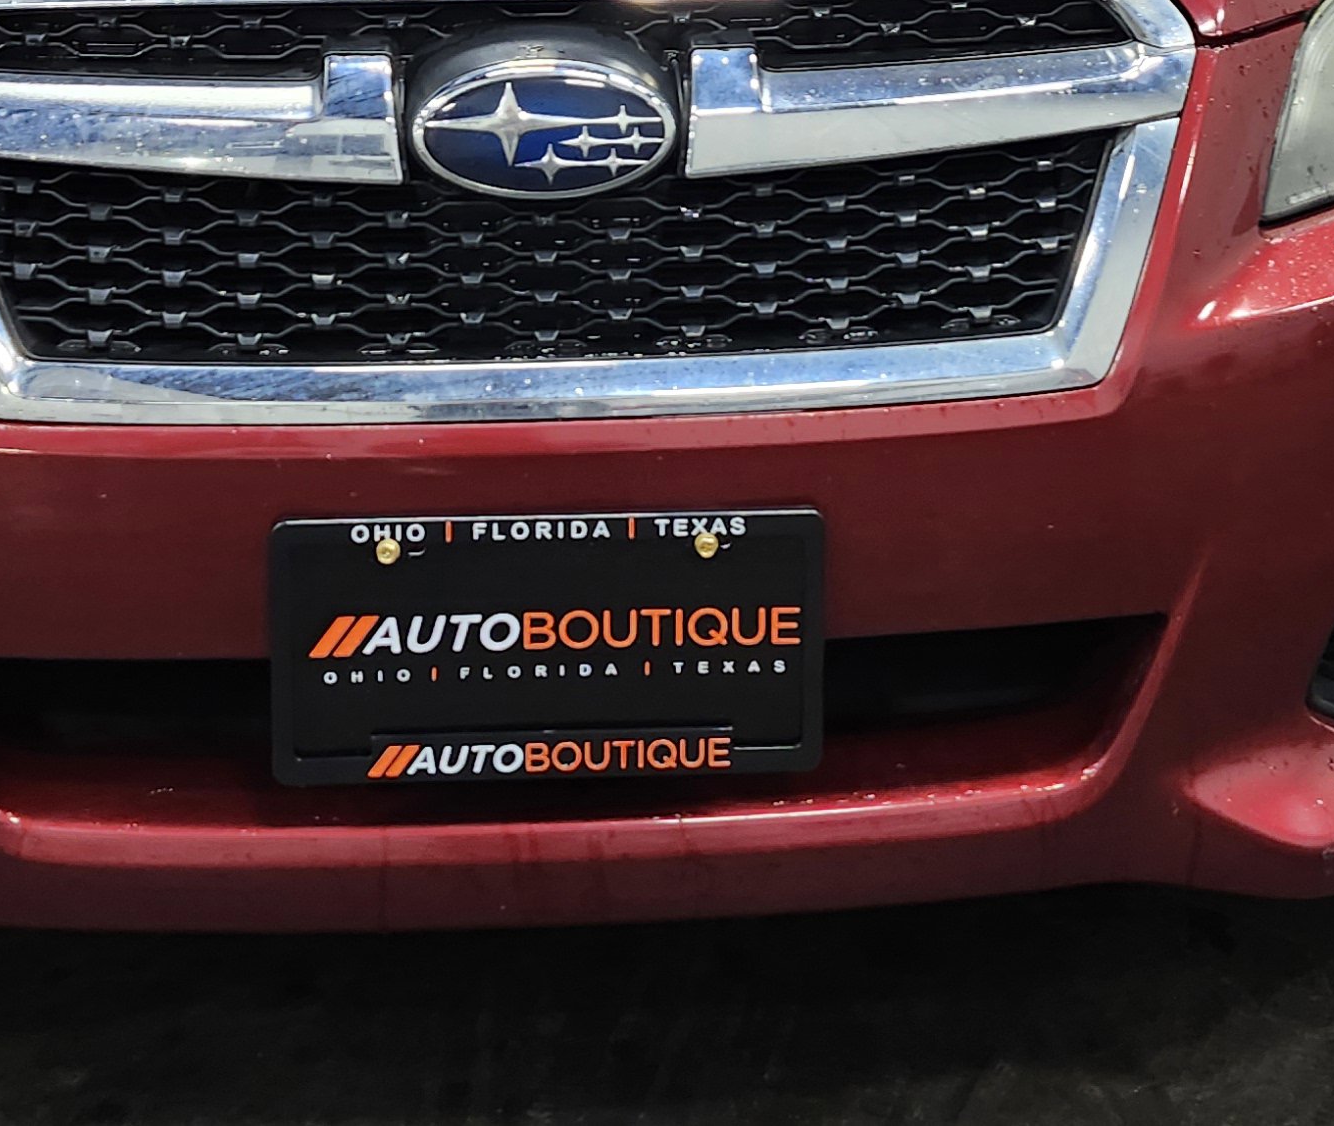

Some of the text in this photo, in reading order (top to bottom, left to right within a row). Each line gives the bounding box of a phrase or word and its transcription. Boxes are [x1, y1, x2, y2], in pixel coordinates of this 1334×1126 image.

[349, 516, 748, 545] OHIO FLORIDA TEXAS
[362, 606, 802, 656] AUTOBOUTIQUE
[323, 659, 787, 685] OHIO FLORIDA TEXAS
[406, 737, 732, 775] AUTOBOUTIQUE
